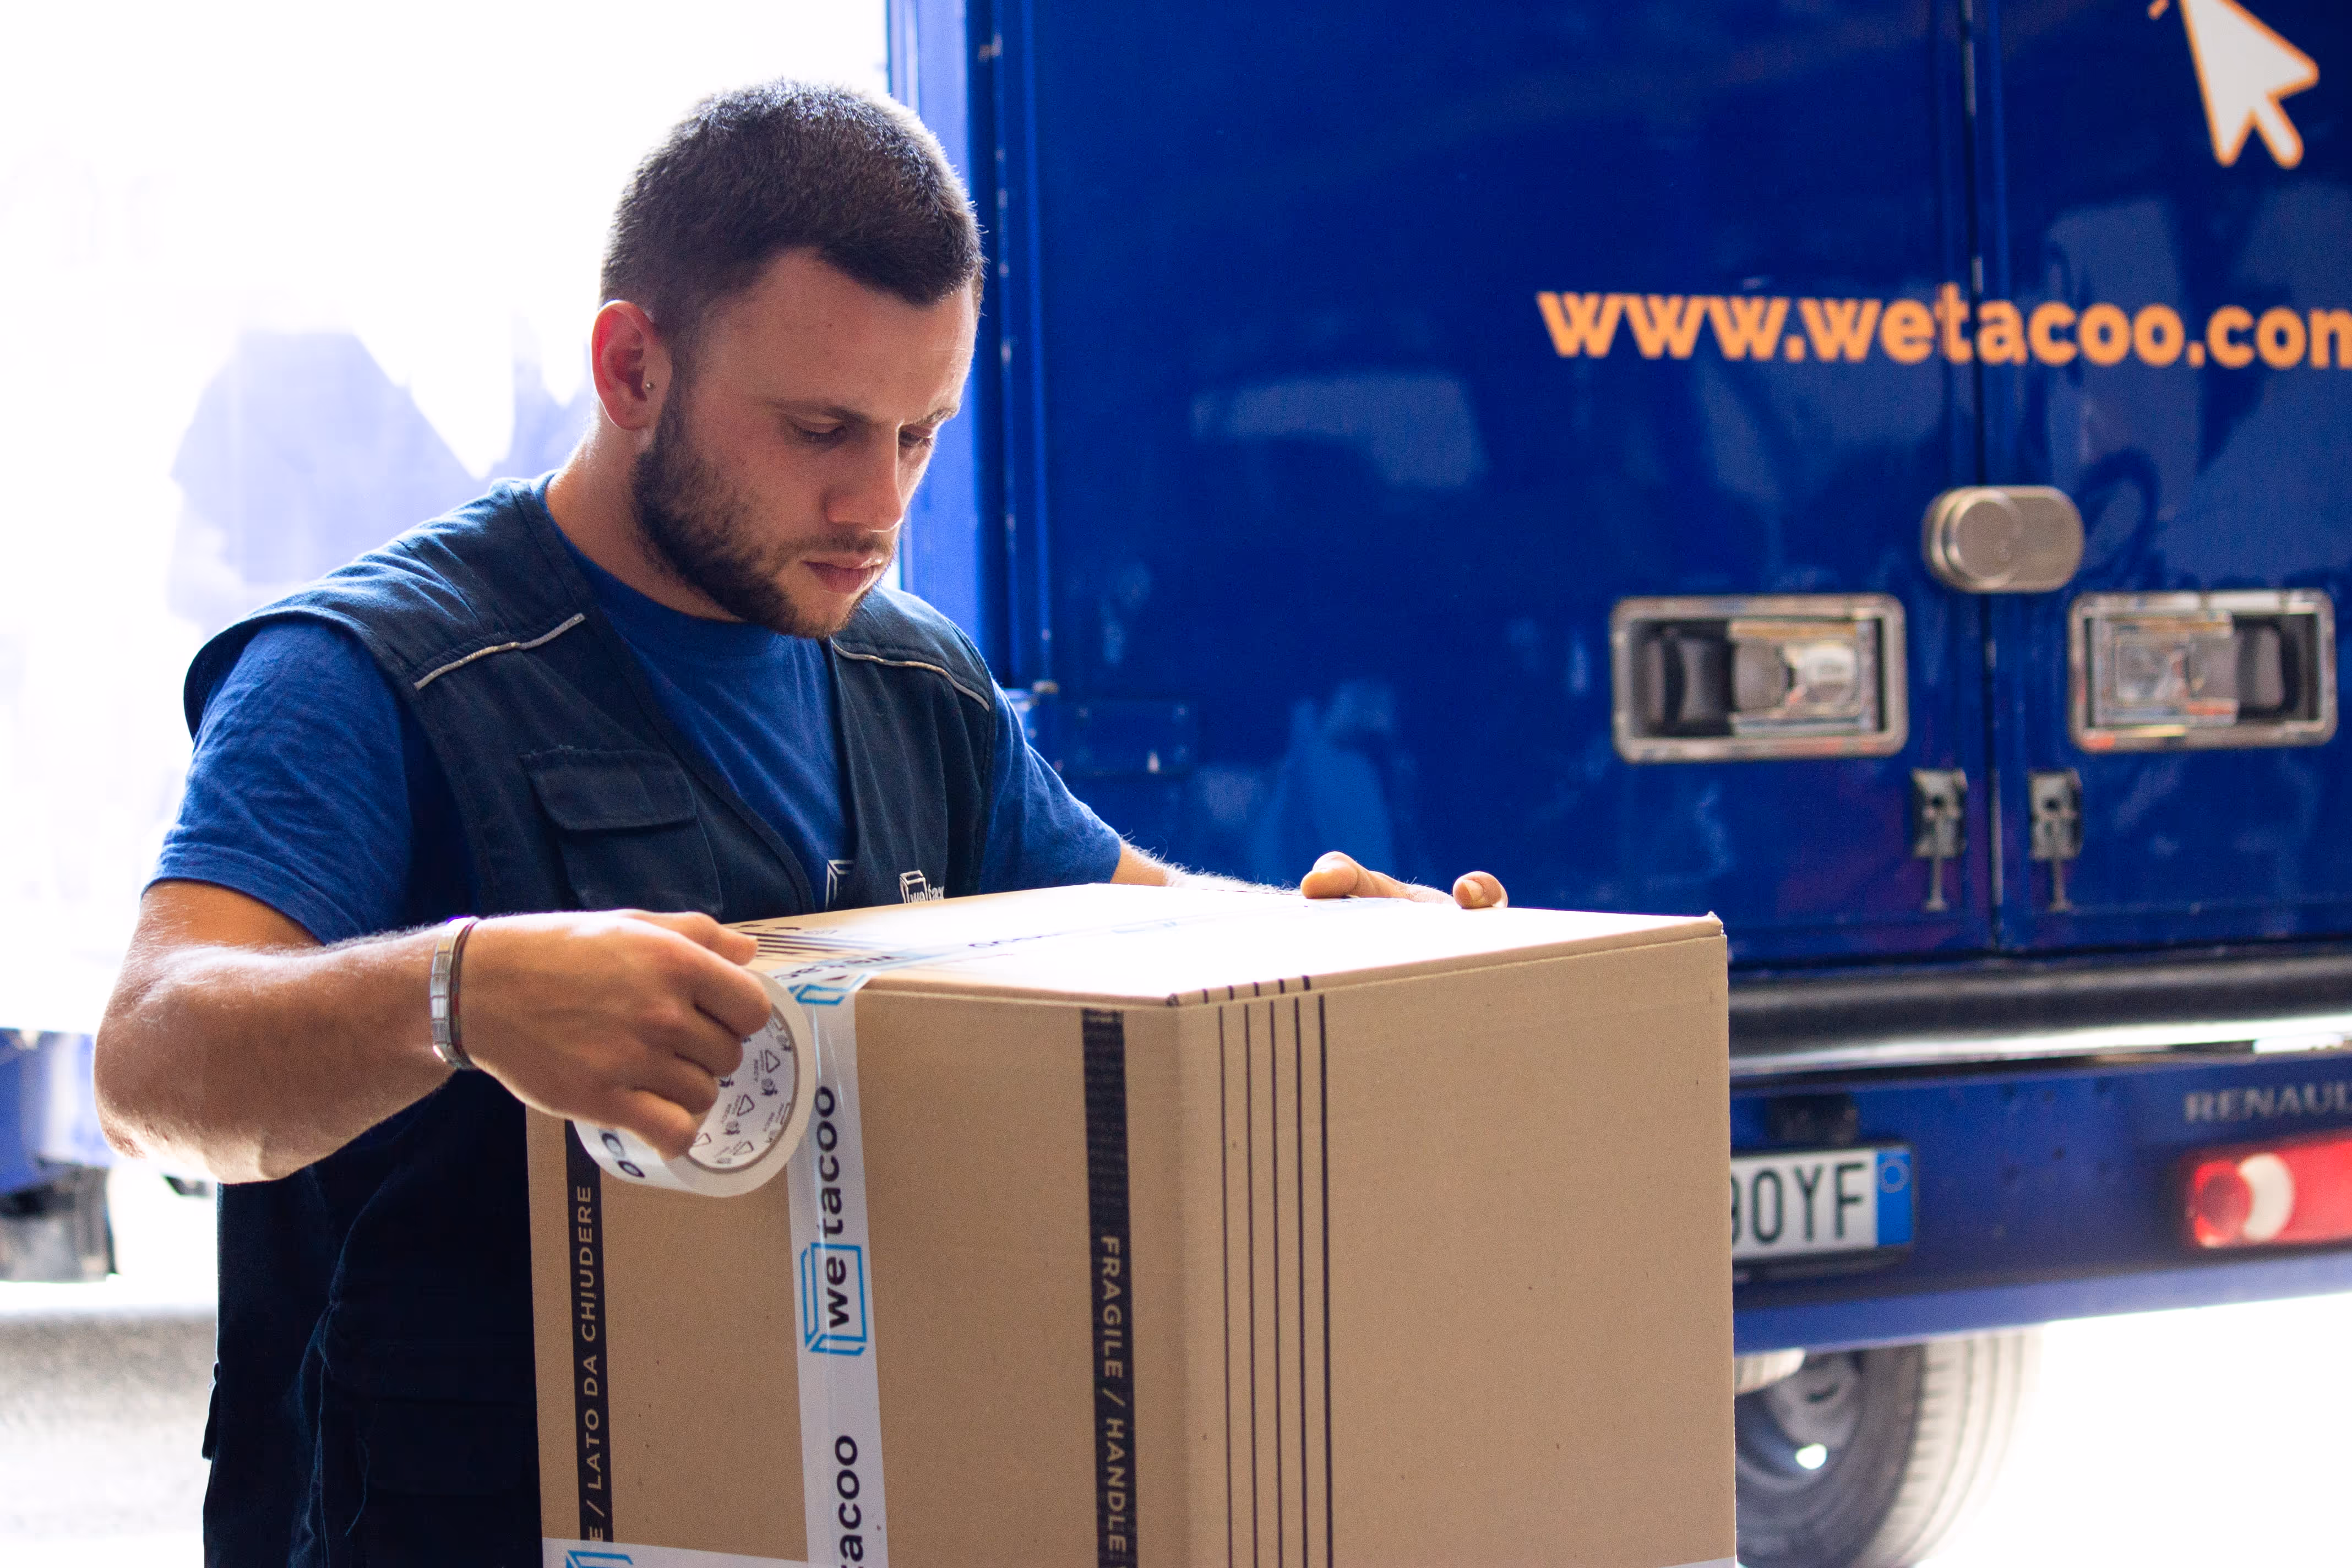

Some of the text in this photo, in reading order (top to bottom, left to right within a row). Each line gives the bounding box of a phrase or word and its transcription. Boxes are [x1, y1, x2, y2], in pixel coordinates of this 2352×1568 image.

[1536, 282, 2352, 368] www.wetacoo.com
[577, 1185, 596, 1342] CHIUDERE
[1102, 1235, 1123, 1378] FRAGILE
[584, 1354, 598, 1397] DA
[585, 1409, 602, 1490] LATO
[835, 1435, 864, 1568] acoo
[1106, 1417, 1128, 1553] HANDLE
